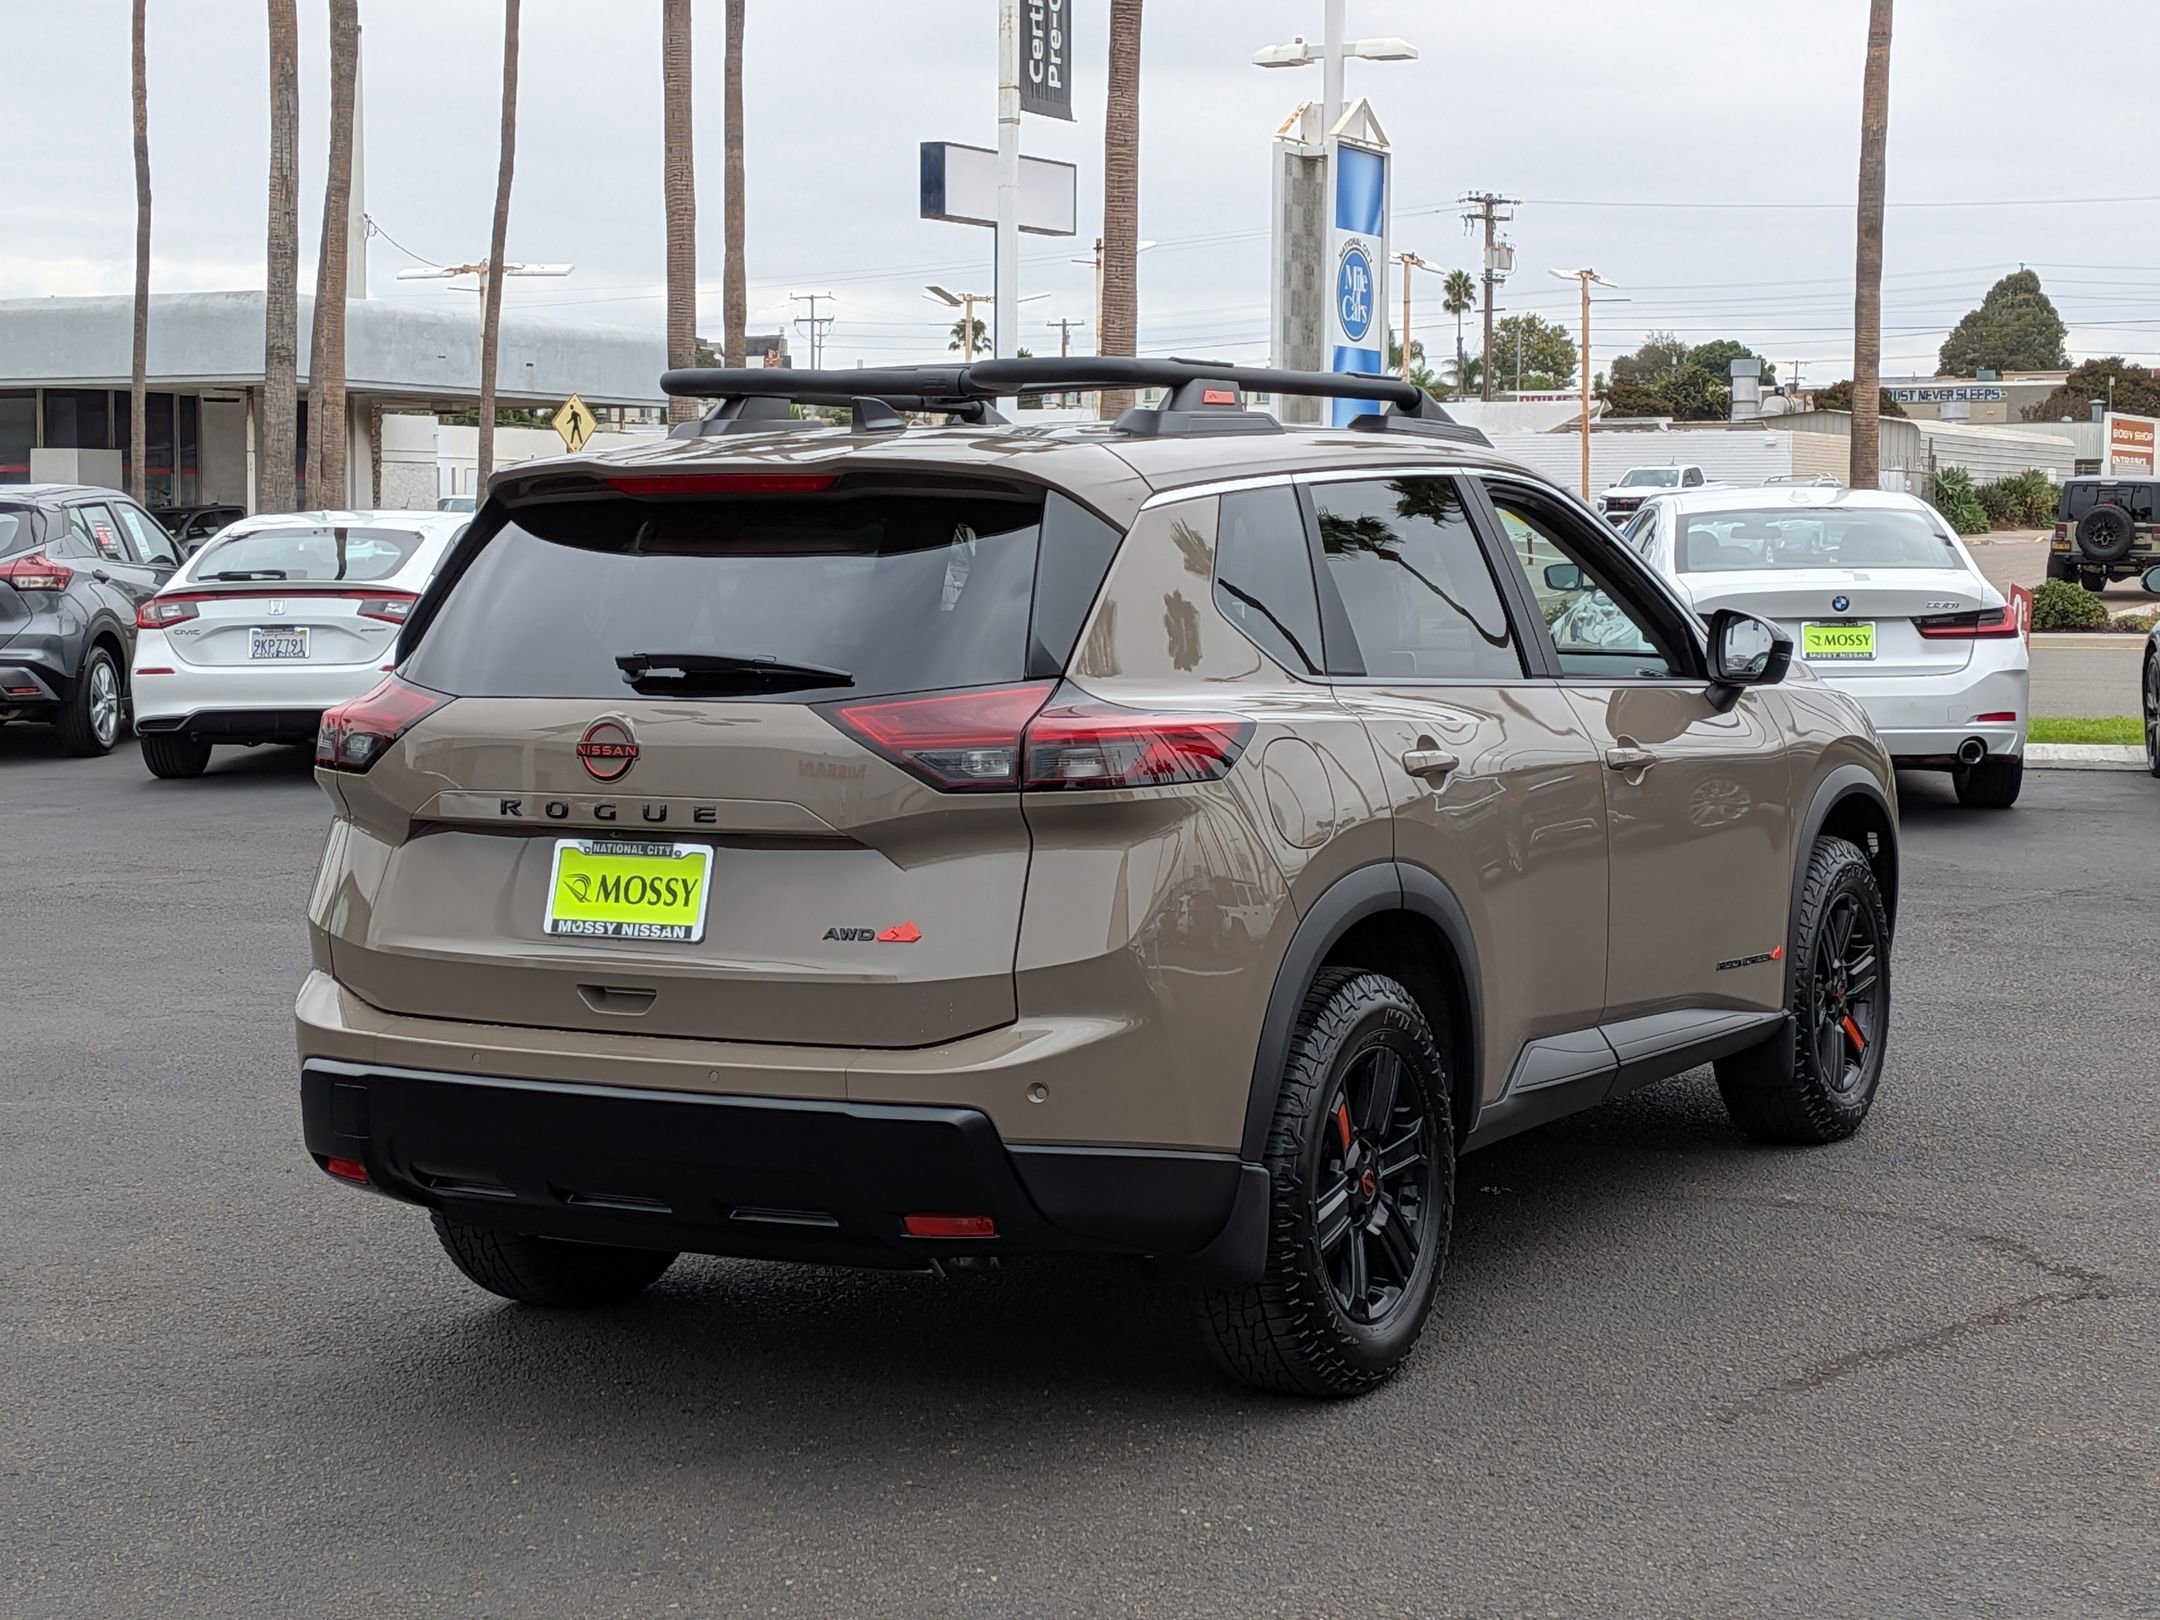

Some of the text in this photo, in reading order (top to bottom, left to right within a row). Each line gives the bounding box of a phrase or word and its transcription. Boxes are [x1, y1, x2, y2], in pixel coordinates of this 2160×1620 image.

[1344, 264, 1369, 293] Mile
[1342, 294, 1368, 323] Cars
[1889, 388, 2001, 402] UST NEVER SLEEPS
[2112, 428, 2154, 442] BODY SHOP
[1824, 633, 1871, 647] MOSSY
[577, 742, 637, 757] NISSAN
[500, 799, 718, 824] ROGUE
[593, 841, 673, 856] NATIONAL CITY
[595, 873, 699, 908] MOSSY
[557, 919, 686, 939] MOSSY NISSAN
[822, 927, 876, 942] AWD
